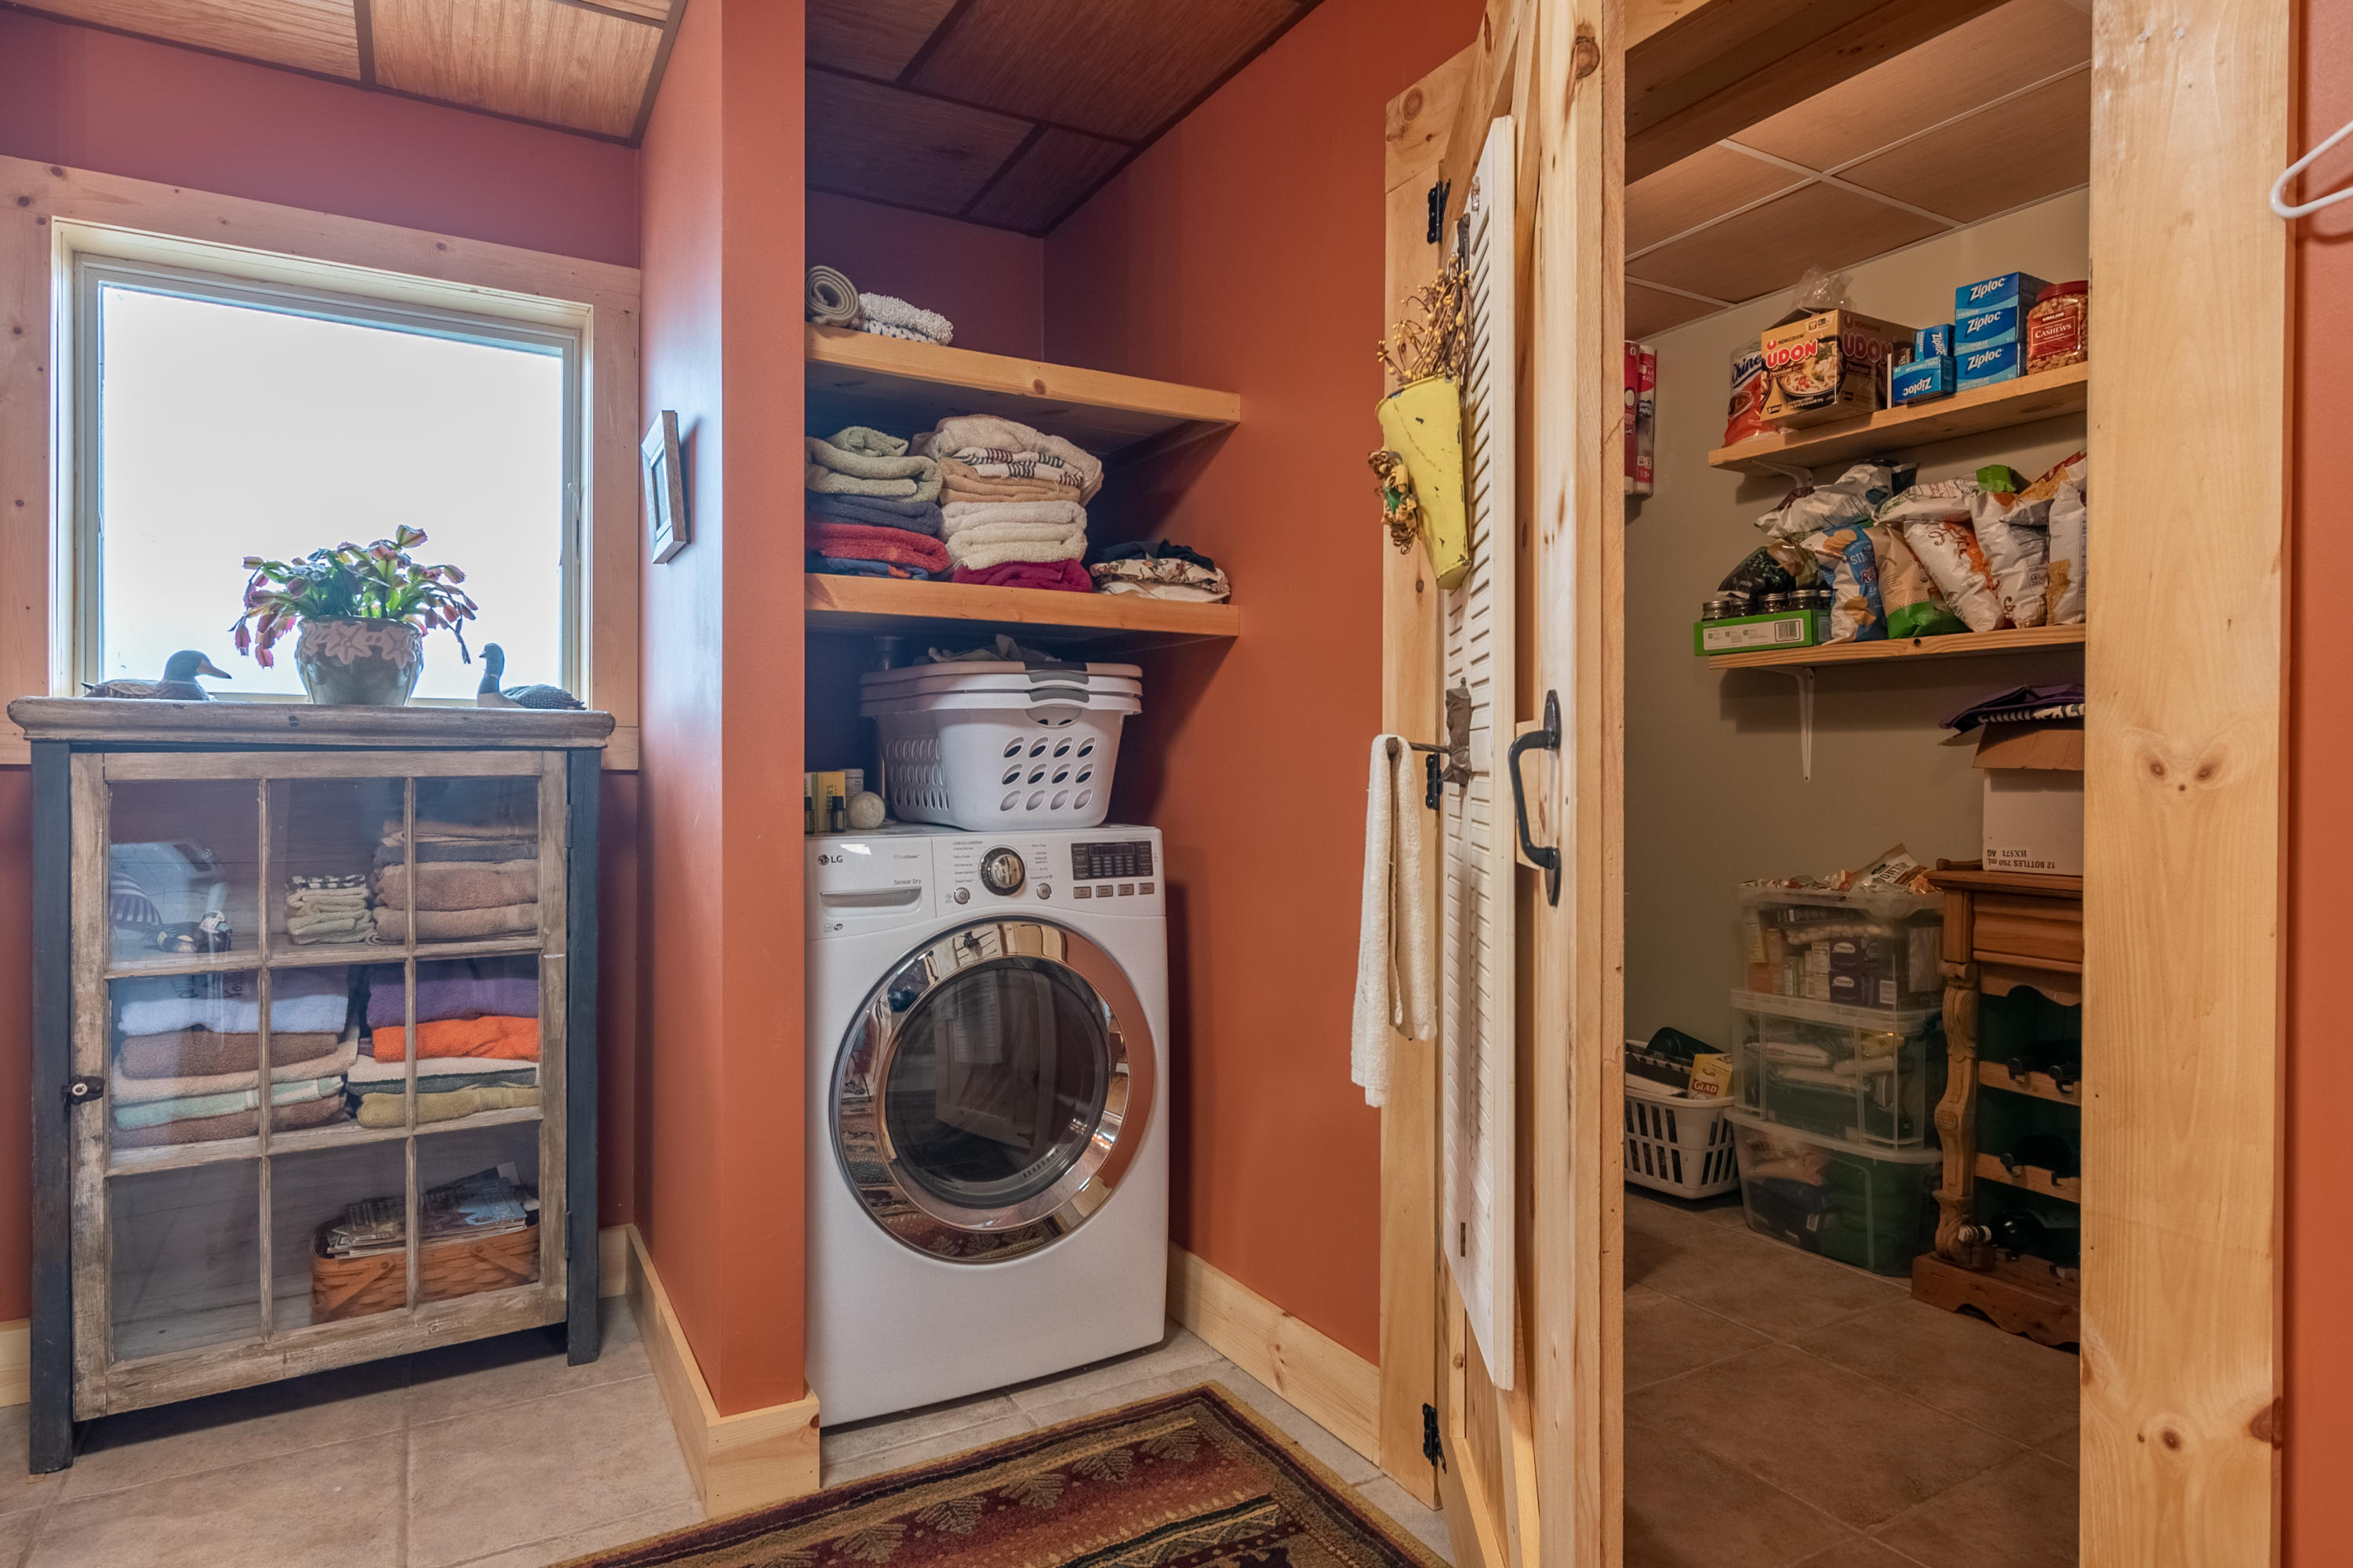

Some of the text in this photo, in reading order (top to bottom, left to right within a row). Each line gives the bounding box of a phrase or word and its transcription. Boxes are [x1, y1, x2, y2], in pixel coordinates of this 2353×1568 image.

[1969, 277, 2006, 301] Ziploc
[1967, 311, 2001, 333] Ziploc
[2035, 323, 2072, 339] CASHEWS
[1778, 333, 1804, 344] NONGSHIM
[1931, 332, 1943, 355] Ziploc
[1766, 339, 1818, 369] UDON
[1967, 348, 2002, 371] Ziploc
[1732, 354, 1762, 384] Chine
[1903, 377, 1933, 396] Ziploc
[2013, 860, 2045, 868] BOTTLES
[1694, 1081, 1717, 1093] GLAD
